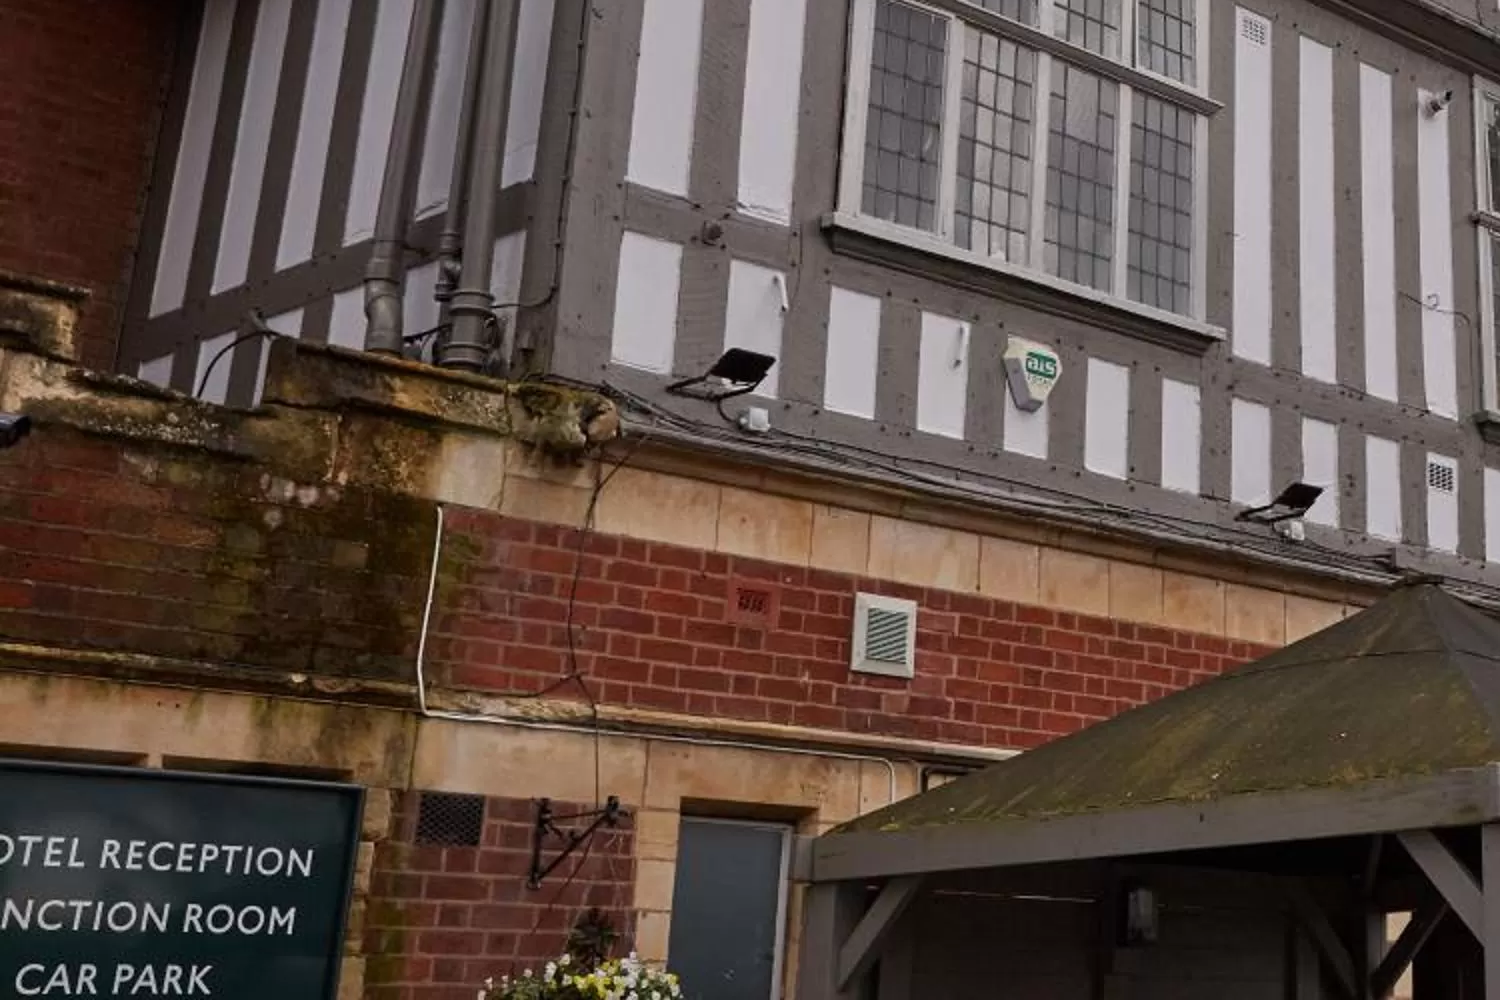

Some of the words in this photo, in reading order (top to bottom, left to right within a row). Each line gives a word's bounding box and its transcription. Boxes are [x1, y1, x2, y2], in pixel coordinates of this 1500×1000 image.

[100, 838, 314, 877] RECEPTION
[1, 899, 170, 932] NCTION
[182, 904, 297, 935] ROOM
[14, 963, 98, 996] CAR
[111, 963, 214, 996] PARK
